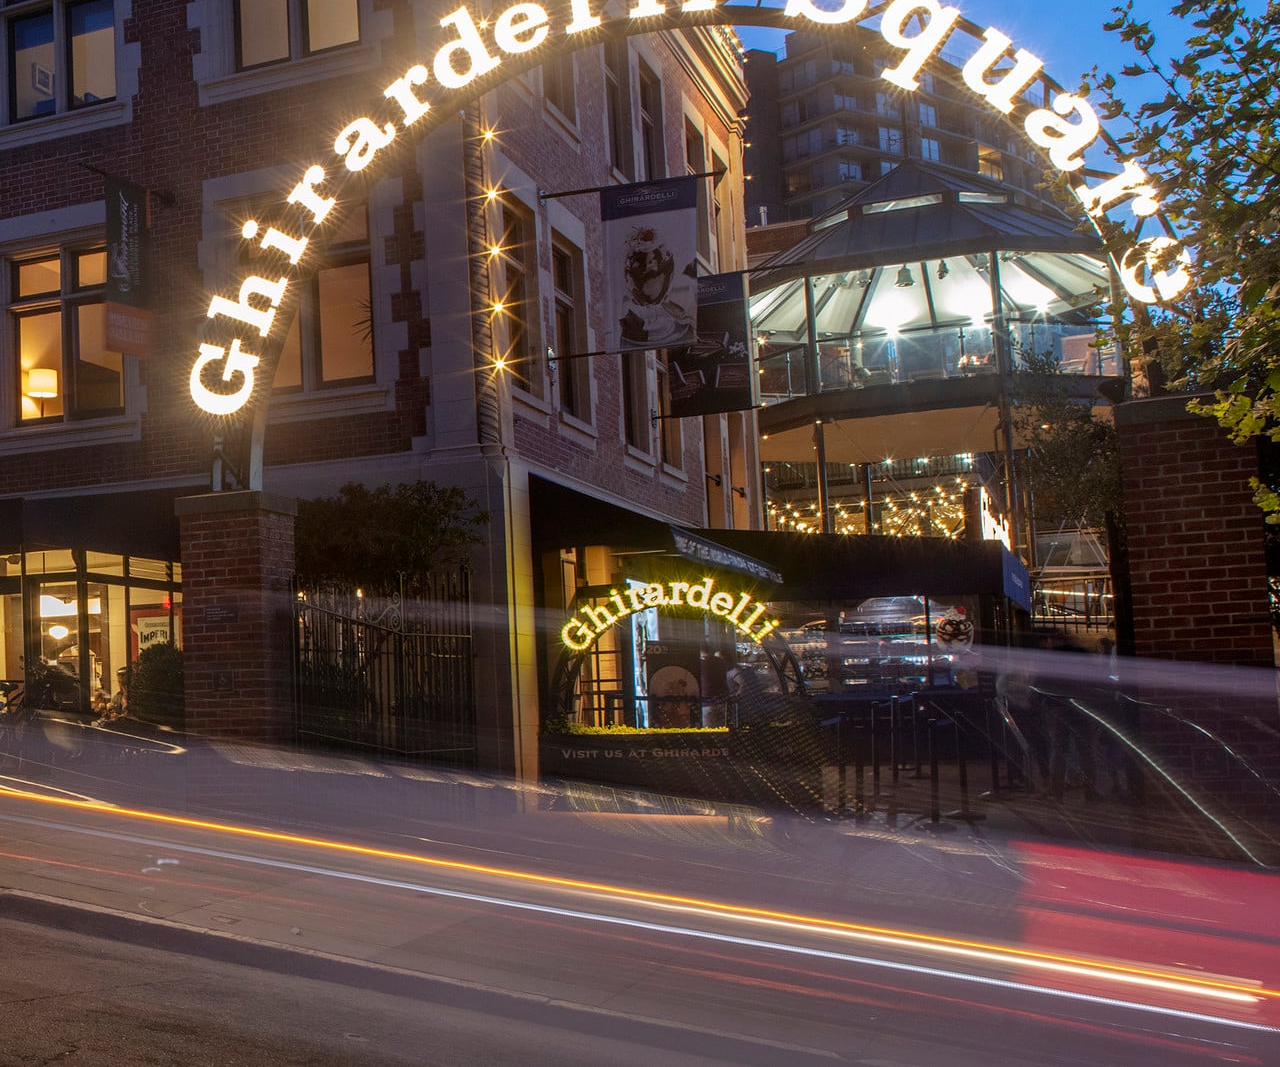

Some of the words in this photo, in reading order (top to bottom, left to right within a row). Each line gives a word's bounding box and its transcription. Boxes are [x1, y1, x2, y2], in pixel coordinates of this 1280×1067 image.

[619, 191, 675, 205] GHIRARDELLI
[561, 577, 780, 651] Ghirardelli
[140, 629, 168, 644] IMPERI
[561, 749, 599, 759] VISIT
[604, 749, 623, 758] US
[628, 748, 648, 758] AT
[652, 747, 730, 758] GHIRARDE
